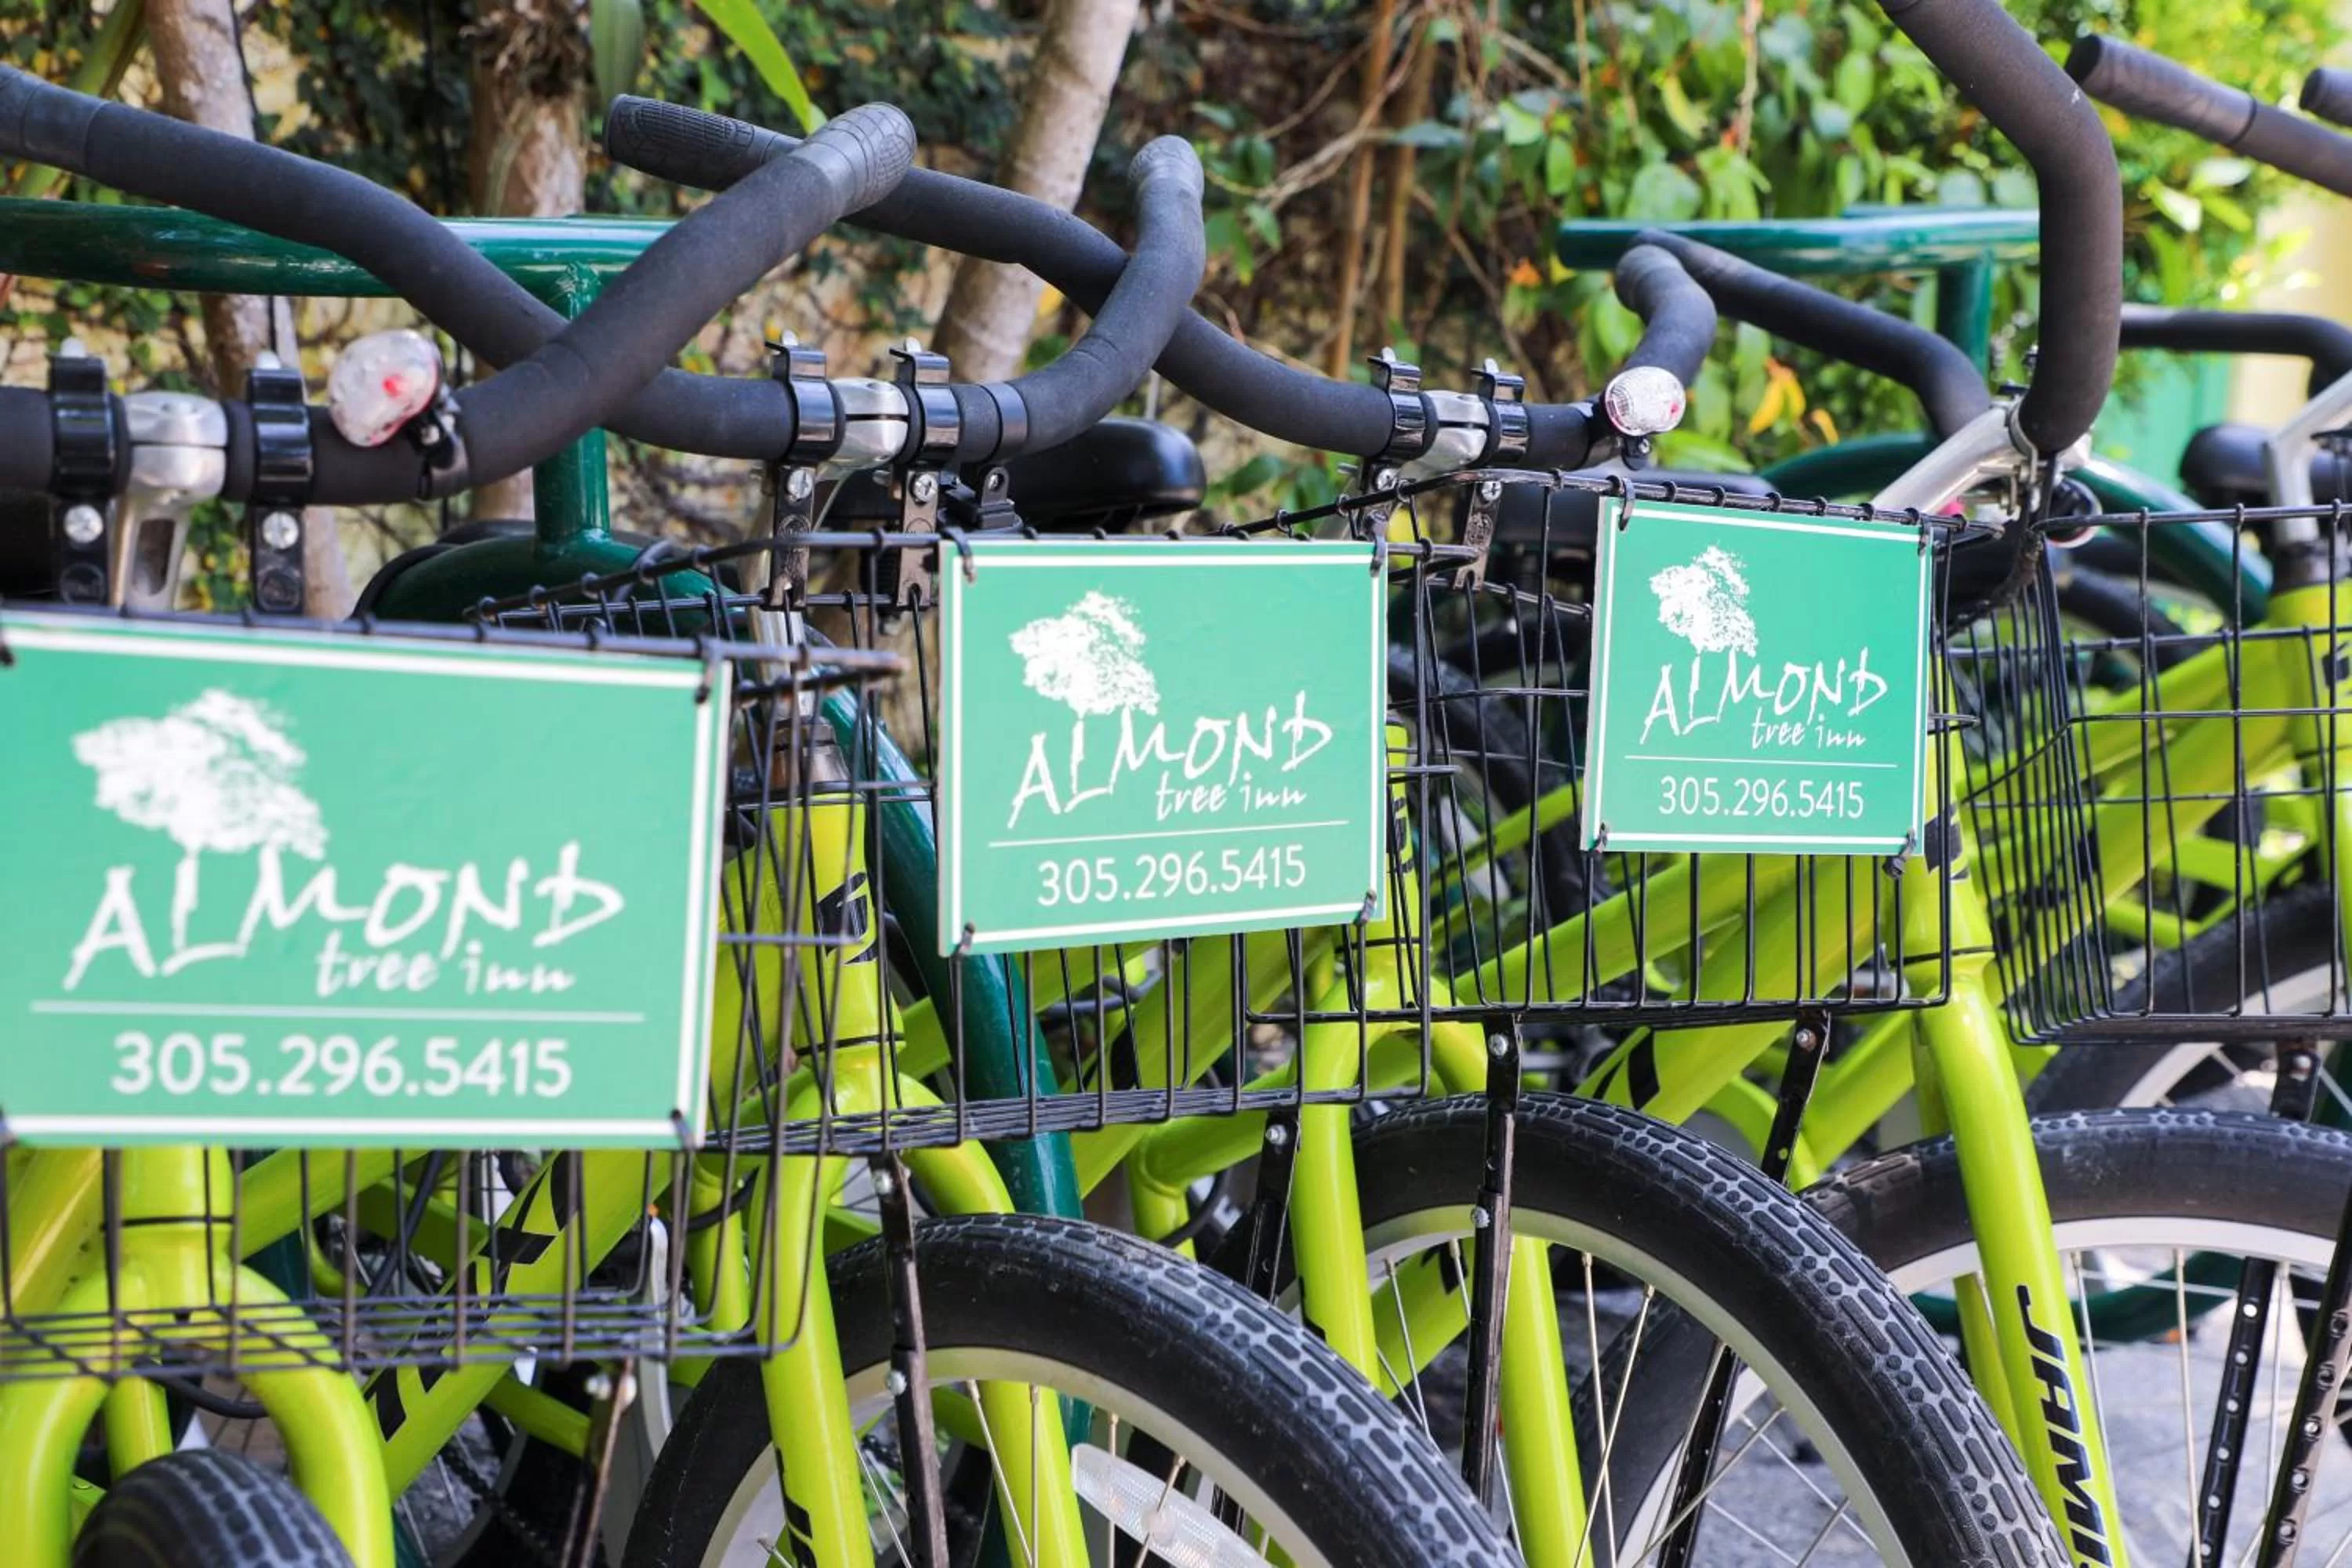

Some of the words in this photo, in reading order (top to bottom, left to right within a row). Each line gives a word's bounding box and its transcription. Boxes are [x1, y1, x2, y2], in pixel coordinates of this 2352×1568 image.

[1639, 648, 1888, 744] ALMOND
[1007, 690, 1334, 829] ALMOND
[1751, 708, 1805, 750] tree
[1816, 714, 1866, 749] inn
[1156, 771, 1227, 822] tree
[1240, 771, 1307, 813] inn
[1658, 775, 1864, 818] 305.296.5415
[1036, 844, 1307, 906] 305.296.5415
[64, 839, 625, 989] ALMOND
[317, 931, 437, 996] tree
[463, 940, 575, 993] inn
[111, 1033, 572, 1097] 305.296.5415
[2016, 1284, 2114, 1568] JAMI
